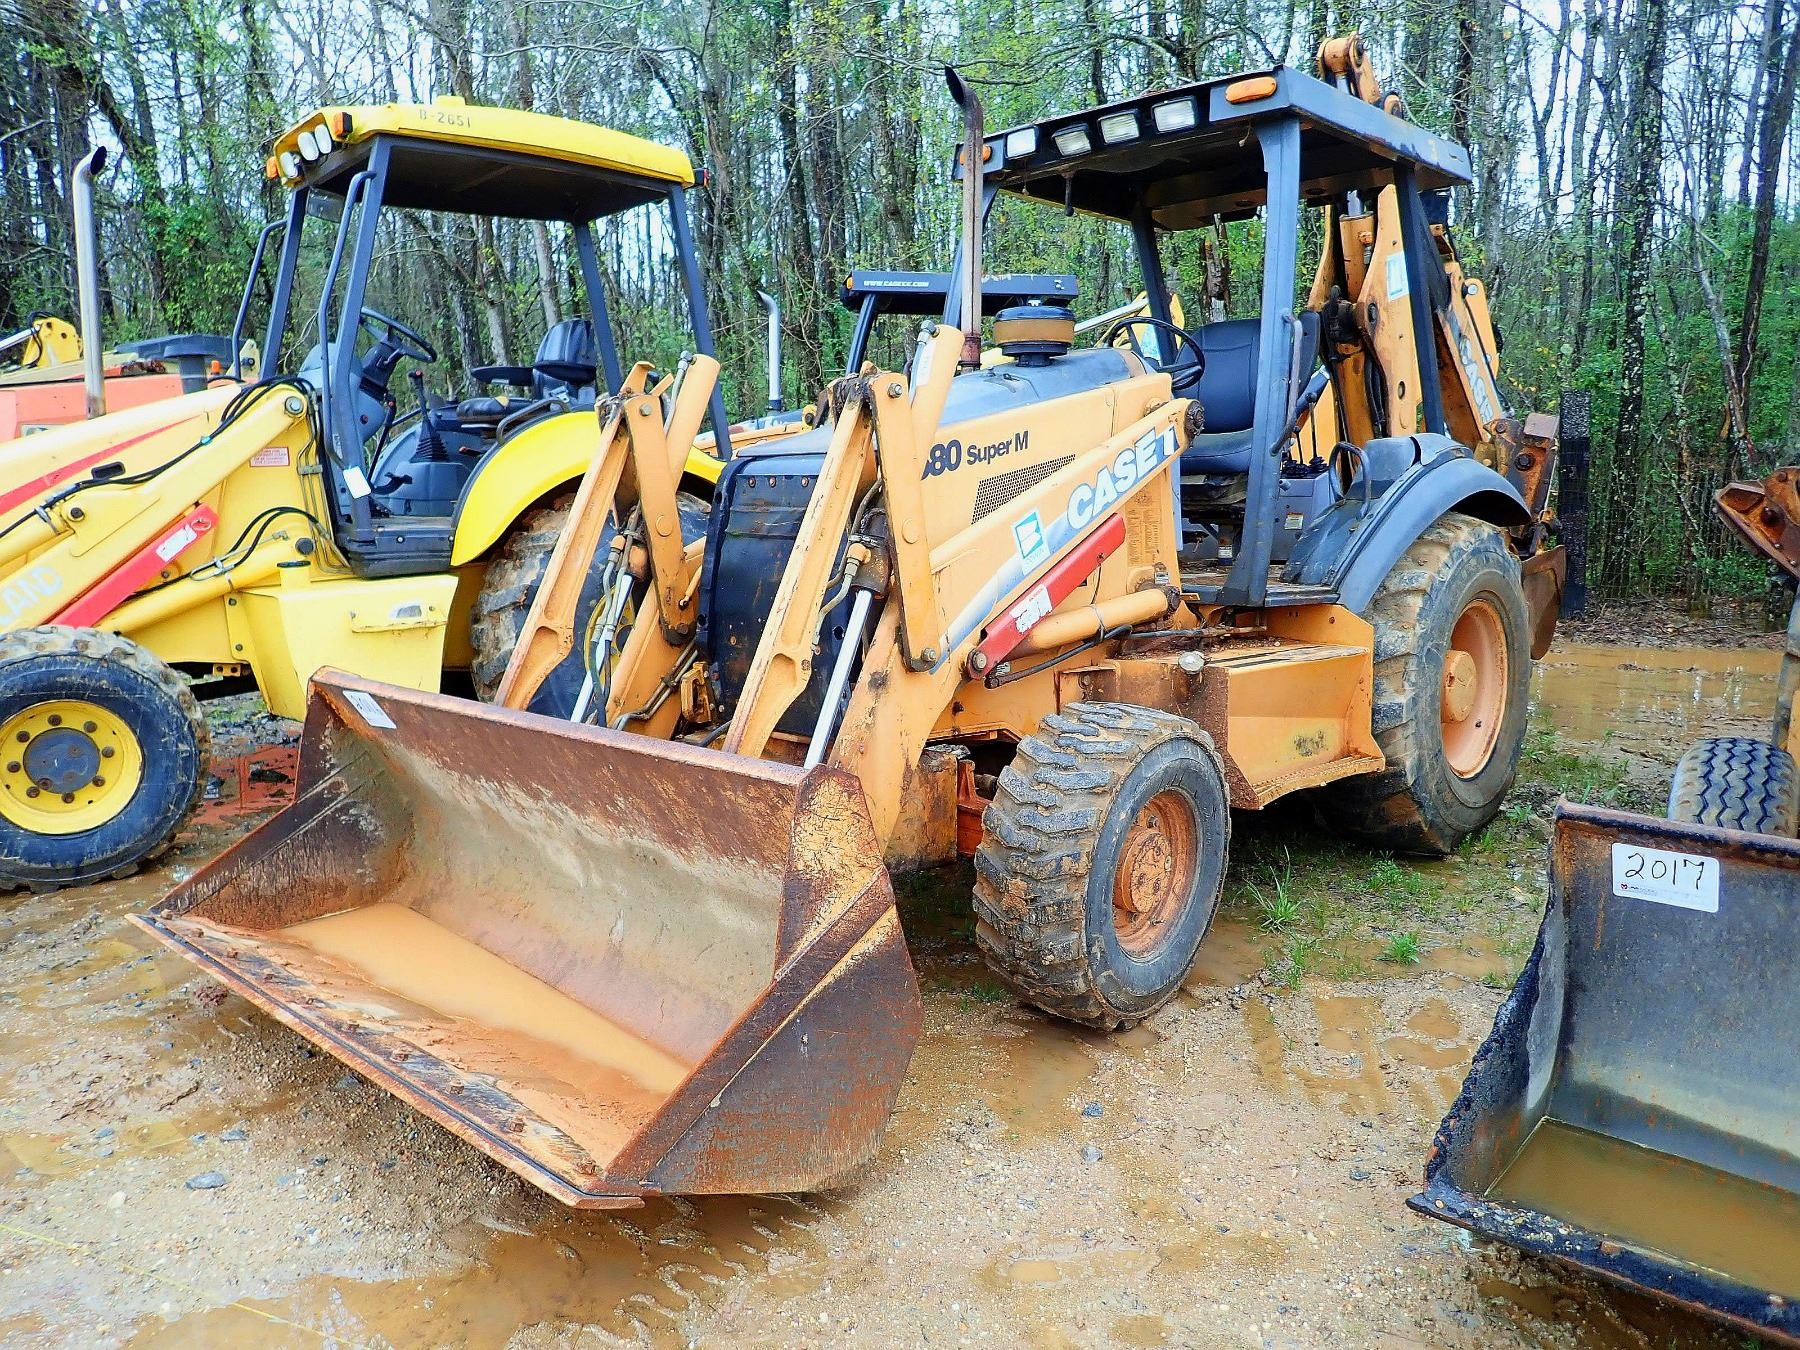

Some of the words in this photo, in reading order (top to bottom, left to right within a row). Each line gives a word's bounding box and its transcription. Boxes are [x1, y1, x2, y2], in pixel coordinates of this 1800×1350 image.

[966, 440, 1012, 465] Super
[1014, 430, 1029, 452] M
[1625, 853, 1705, 890] 2017
